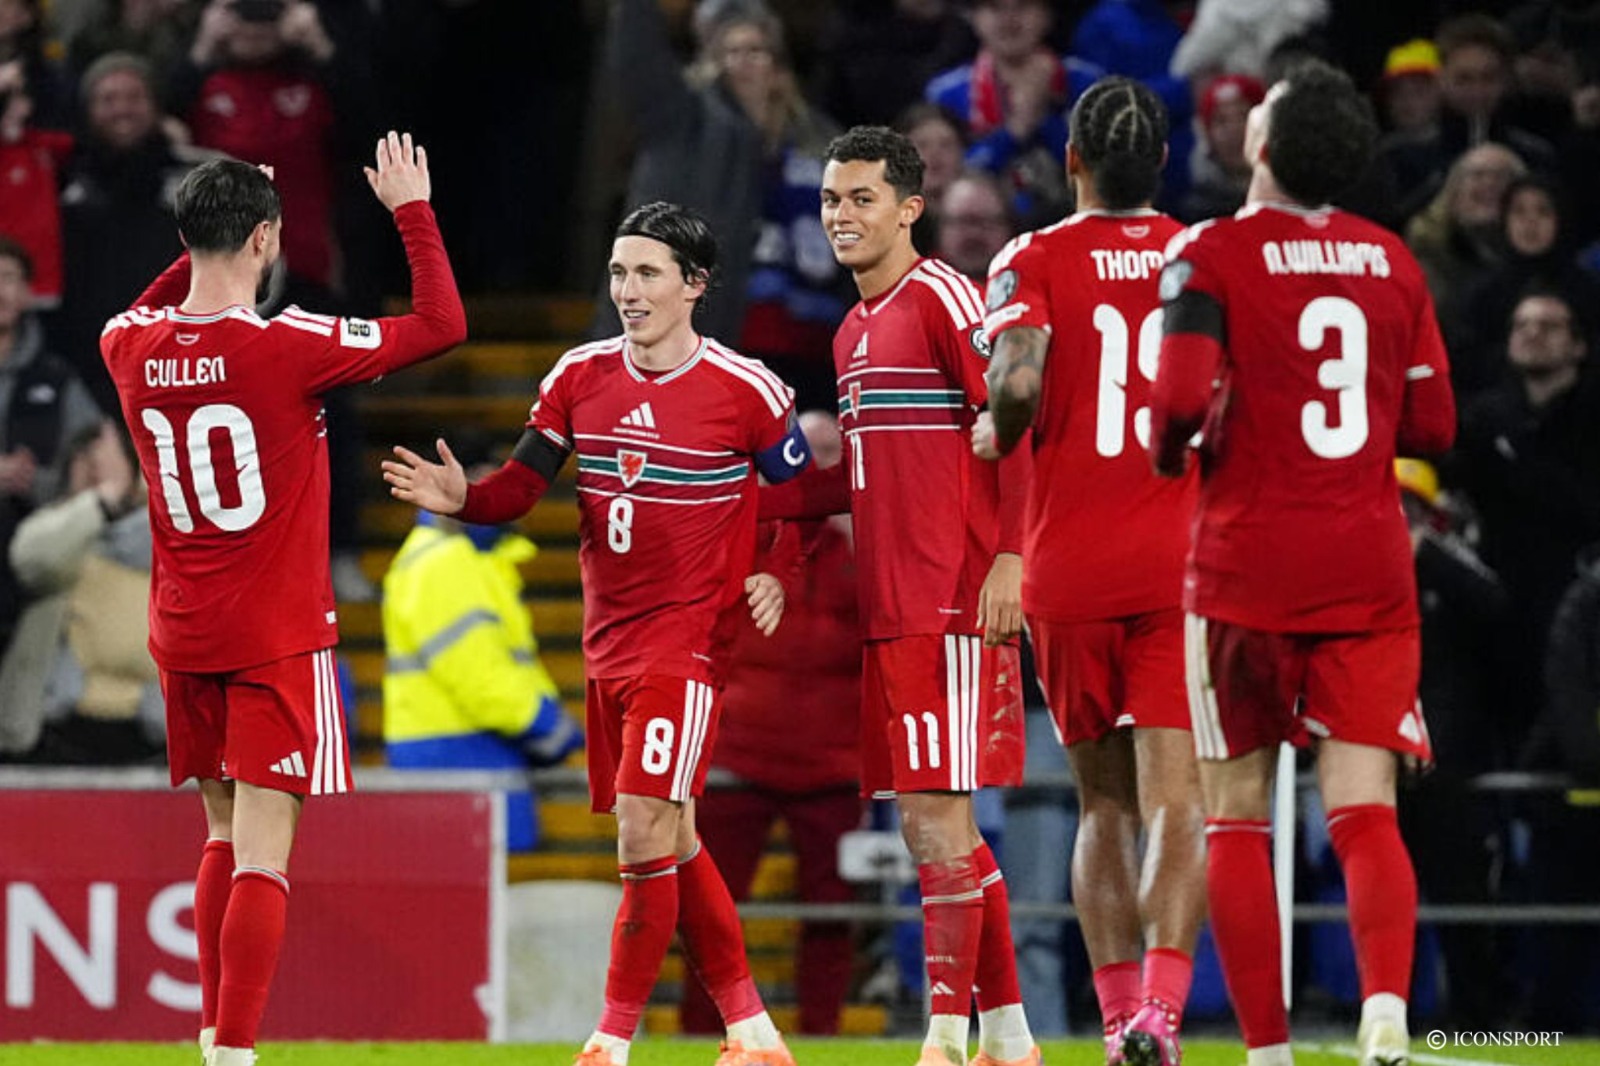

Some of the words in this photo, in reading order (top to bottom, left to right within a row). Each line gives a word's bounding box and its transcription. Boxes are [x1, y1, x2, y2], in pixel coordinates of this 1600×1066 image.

[145, 356, 226, 387] CULLEN
[1298, 297, 1368, 459] 3
[141, 404, 266, 533] 10
[782, 437, 804, 466] C
[607, 497, 634, 554] 8
[641, 717, 674, 775] 8
[903, 711, 940, 771] 11
